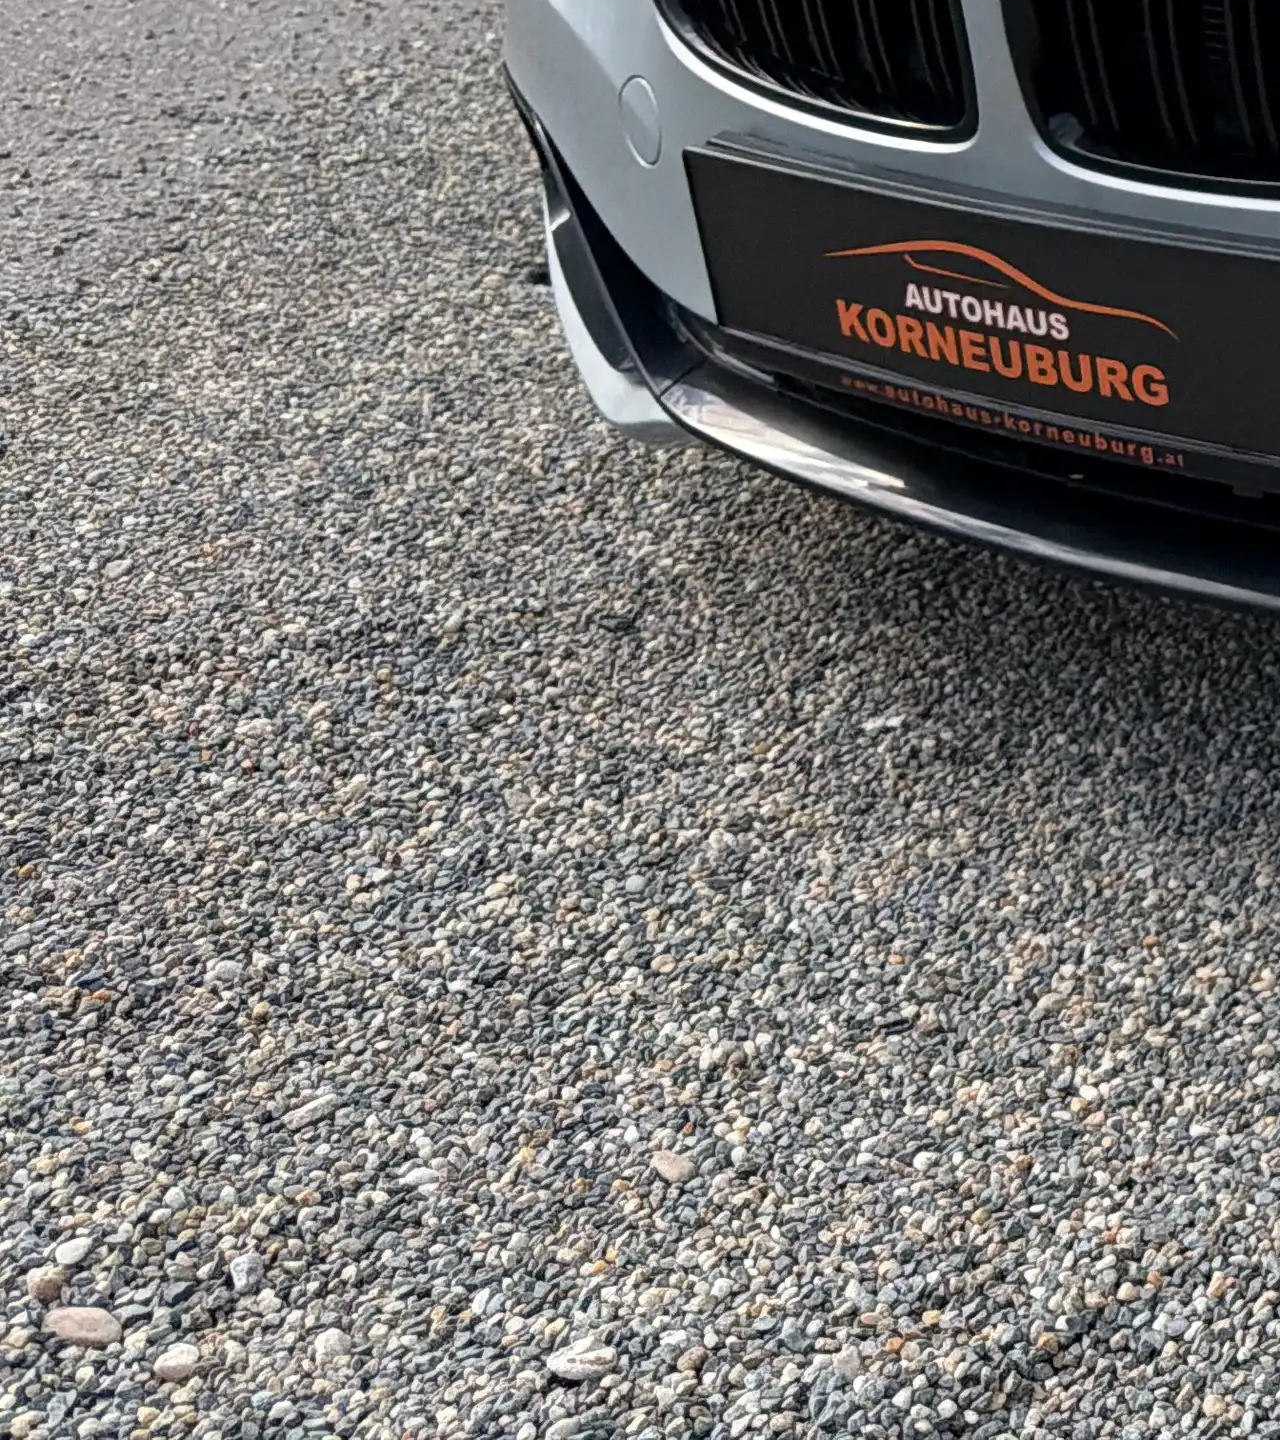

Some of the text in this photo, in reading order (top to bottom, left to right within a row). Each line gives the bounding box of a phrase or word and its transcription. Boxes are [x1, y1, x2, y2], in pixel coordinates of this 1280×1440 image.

[836, 299, 1169, 407] KORNEUBURG
[905, 283, 1069, 341] AUTOHAUS
[840, 376, 1184, 468] www.autohaus-korneuburg.at
